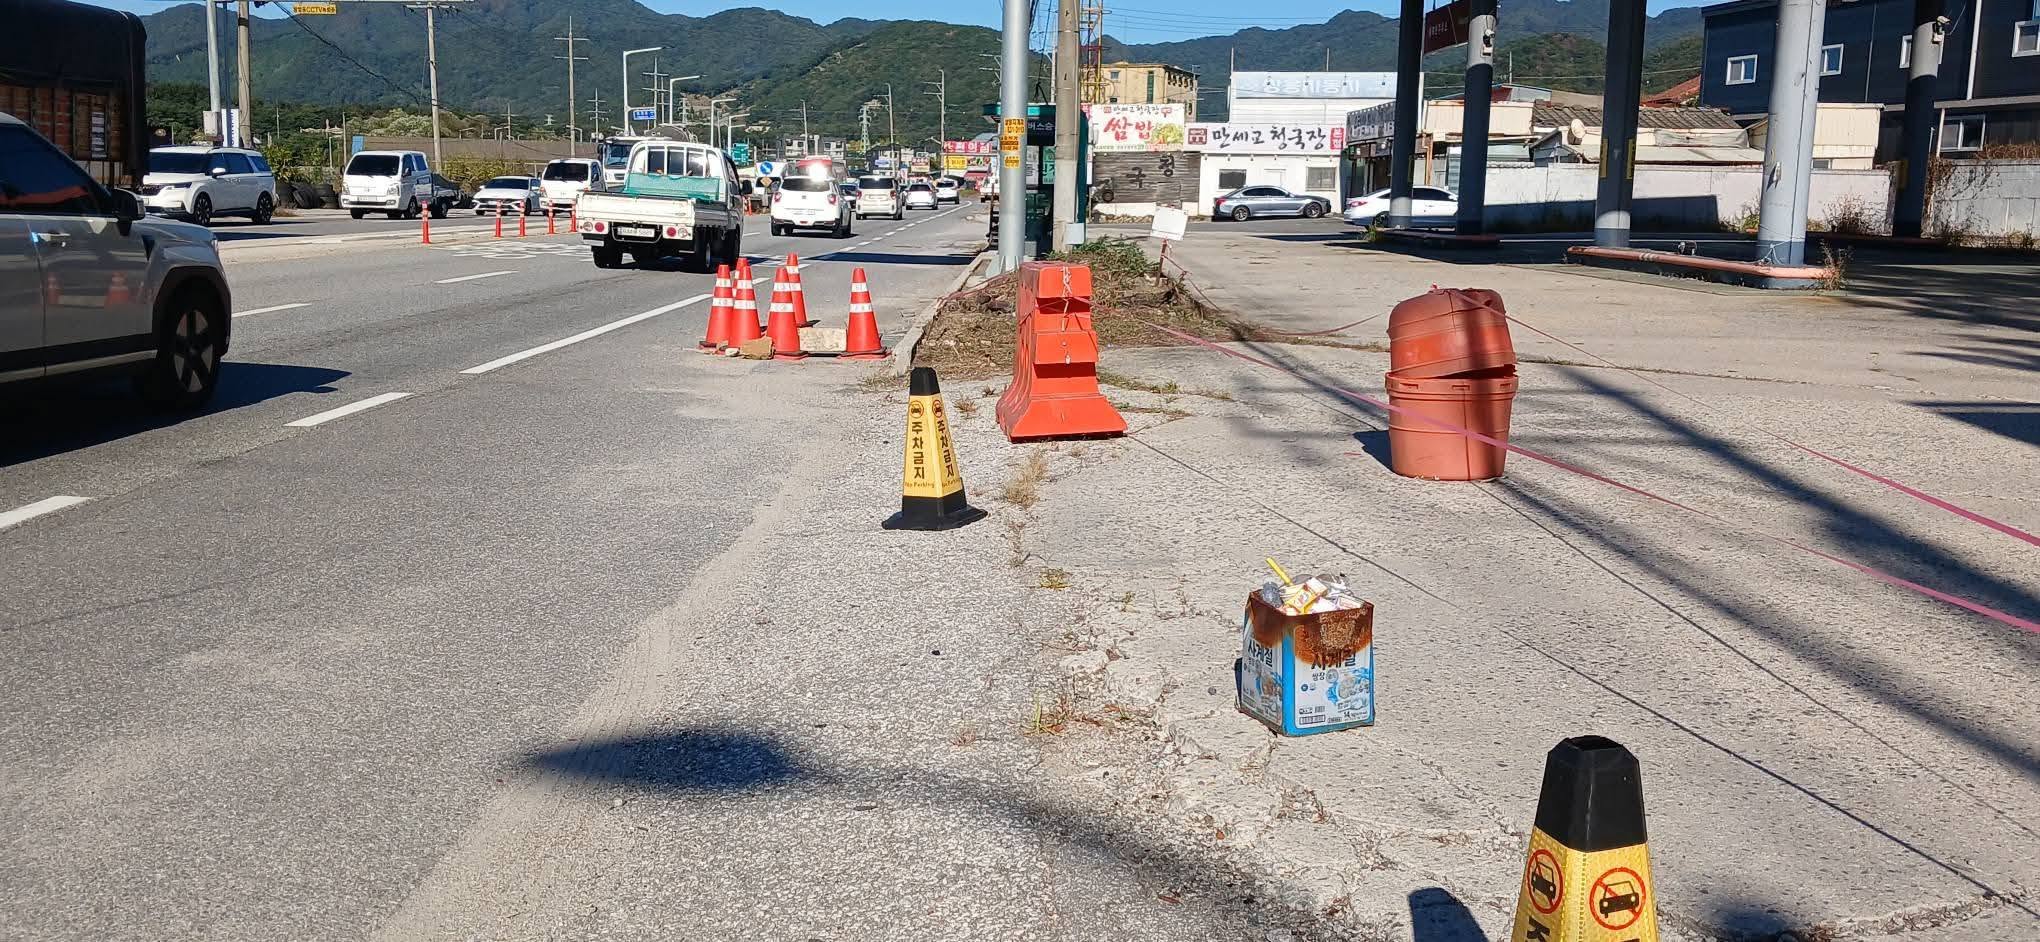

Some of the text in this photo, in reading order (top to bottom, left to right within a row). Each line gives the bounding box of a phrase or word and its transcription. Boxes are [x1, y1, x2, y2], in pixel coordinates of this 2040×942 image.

[1103, 116, 1153, 141] 쌈밥
[1270, 126, 1326, 150] 청국장
[912, 422, 925, 479] 주차금지
[937, 420, 954, 477] 주차금지
[1248, 640, 1272, 667] 사계절
